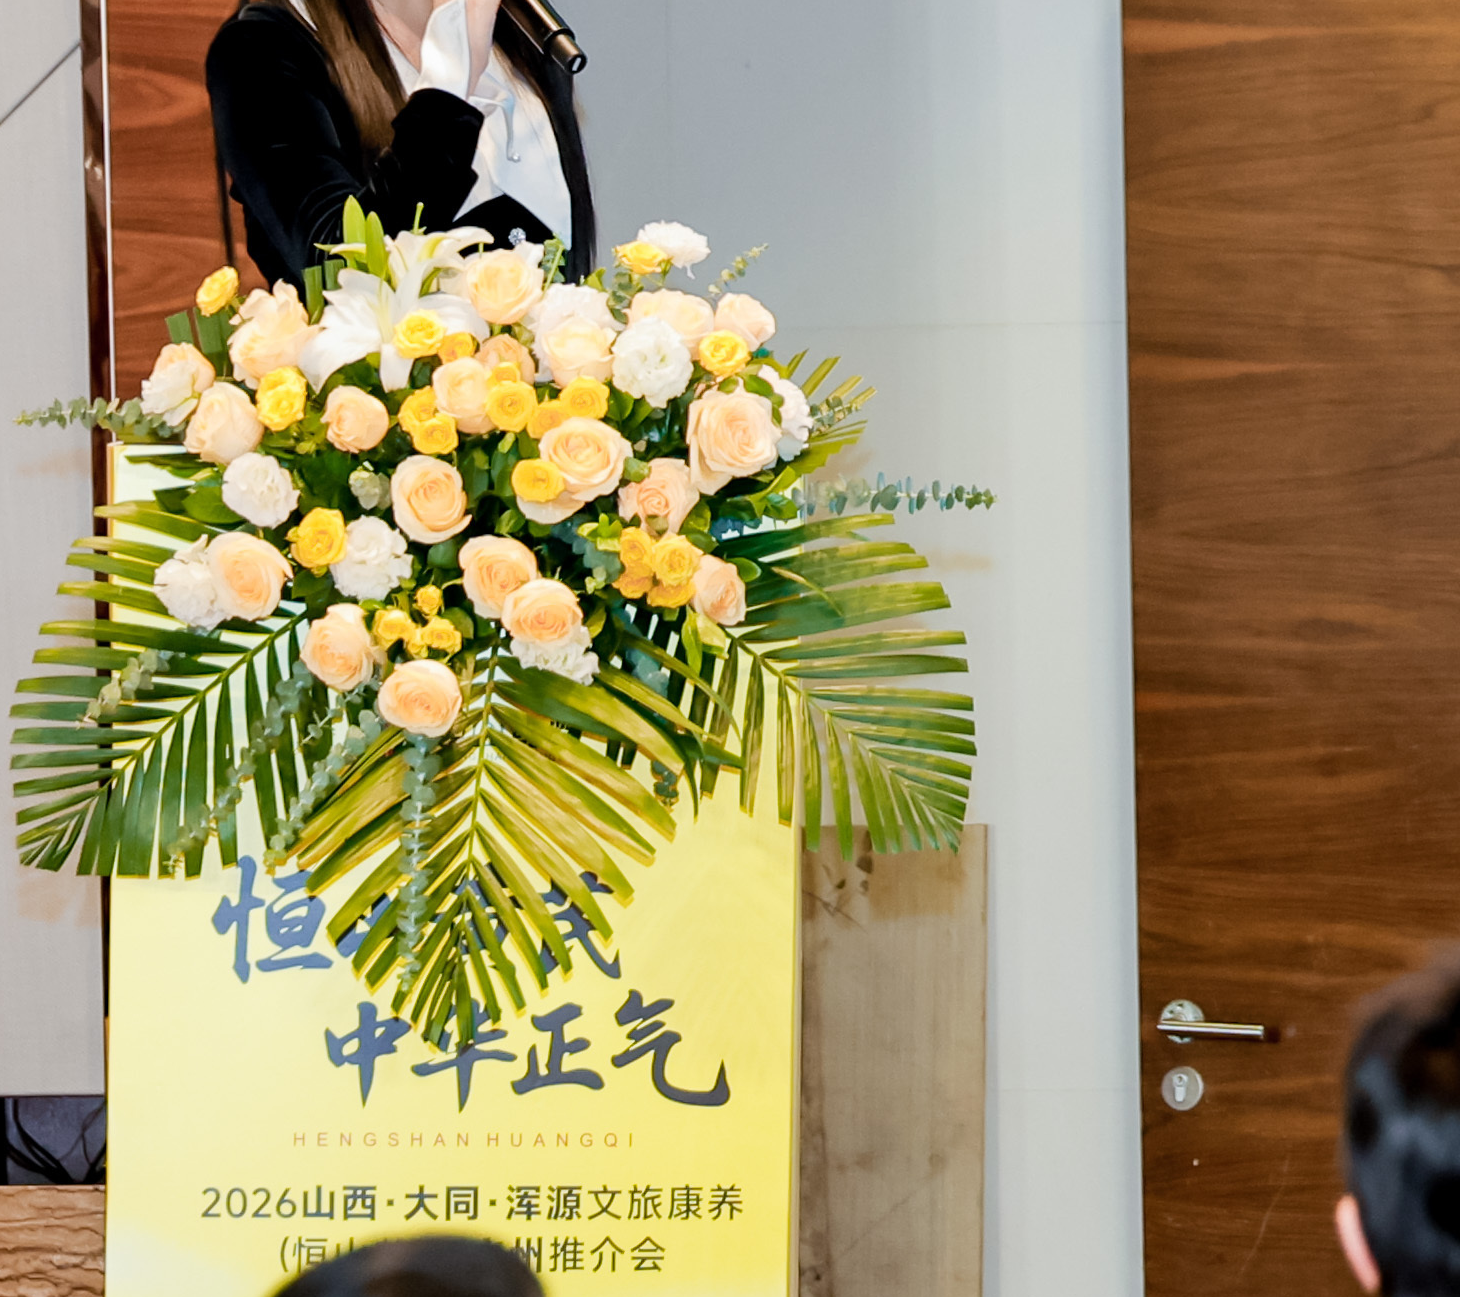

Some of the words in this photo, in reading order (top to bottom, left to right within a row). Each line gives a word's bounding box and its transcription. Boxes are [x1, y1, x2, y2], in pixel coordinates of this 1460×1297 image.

[293, 1132, 469, 1148] HENGSHAN
[487, 1132, 633, 1148] HUANGQI
[201, 1184, 744, 1222] 2026山西·大同·浑源文旅康养
